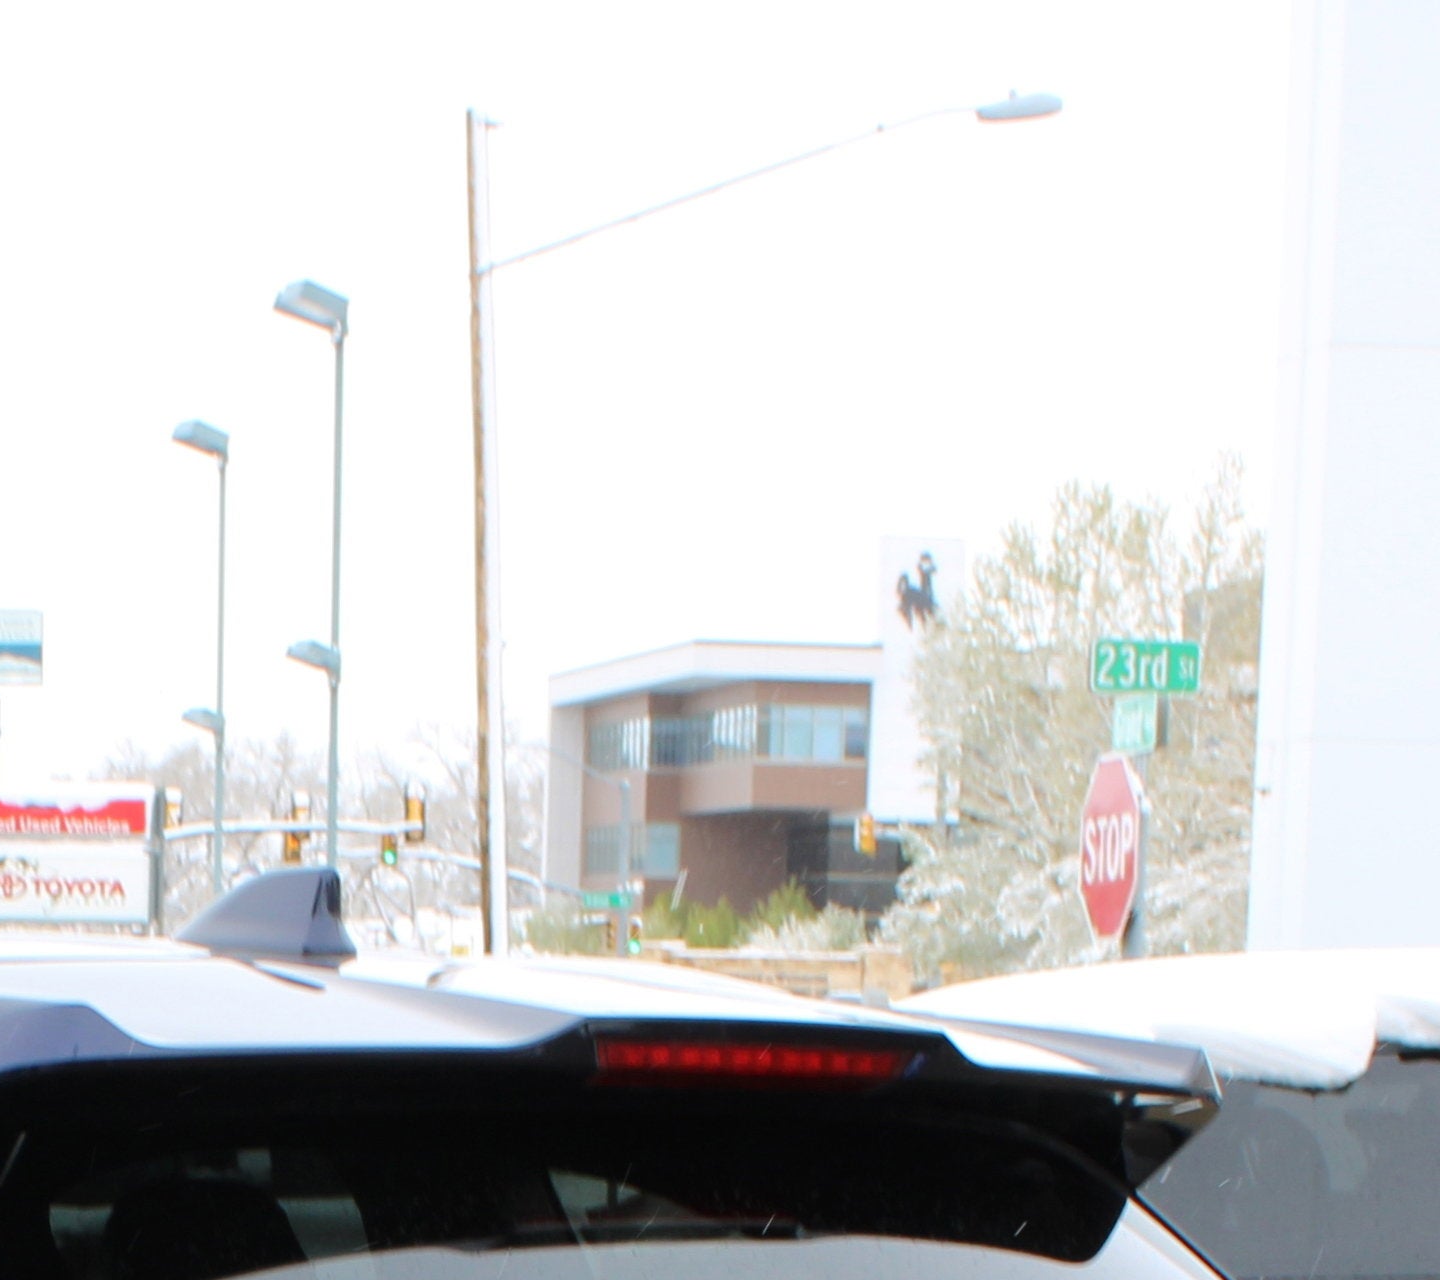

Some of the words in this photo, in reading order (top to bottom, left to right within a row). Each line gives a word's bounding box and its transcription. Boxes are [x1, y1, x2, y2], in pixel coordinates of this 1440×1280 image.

[1098, 645, 1169, 688] 23rd
[21, 815, 61, 835] Used
[64, 817, 130, 836] Vehicles
[1083, 812, 1133, 885] STOP
[33, 875, 126, 898] TOYOTA
